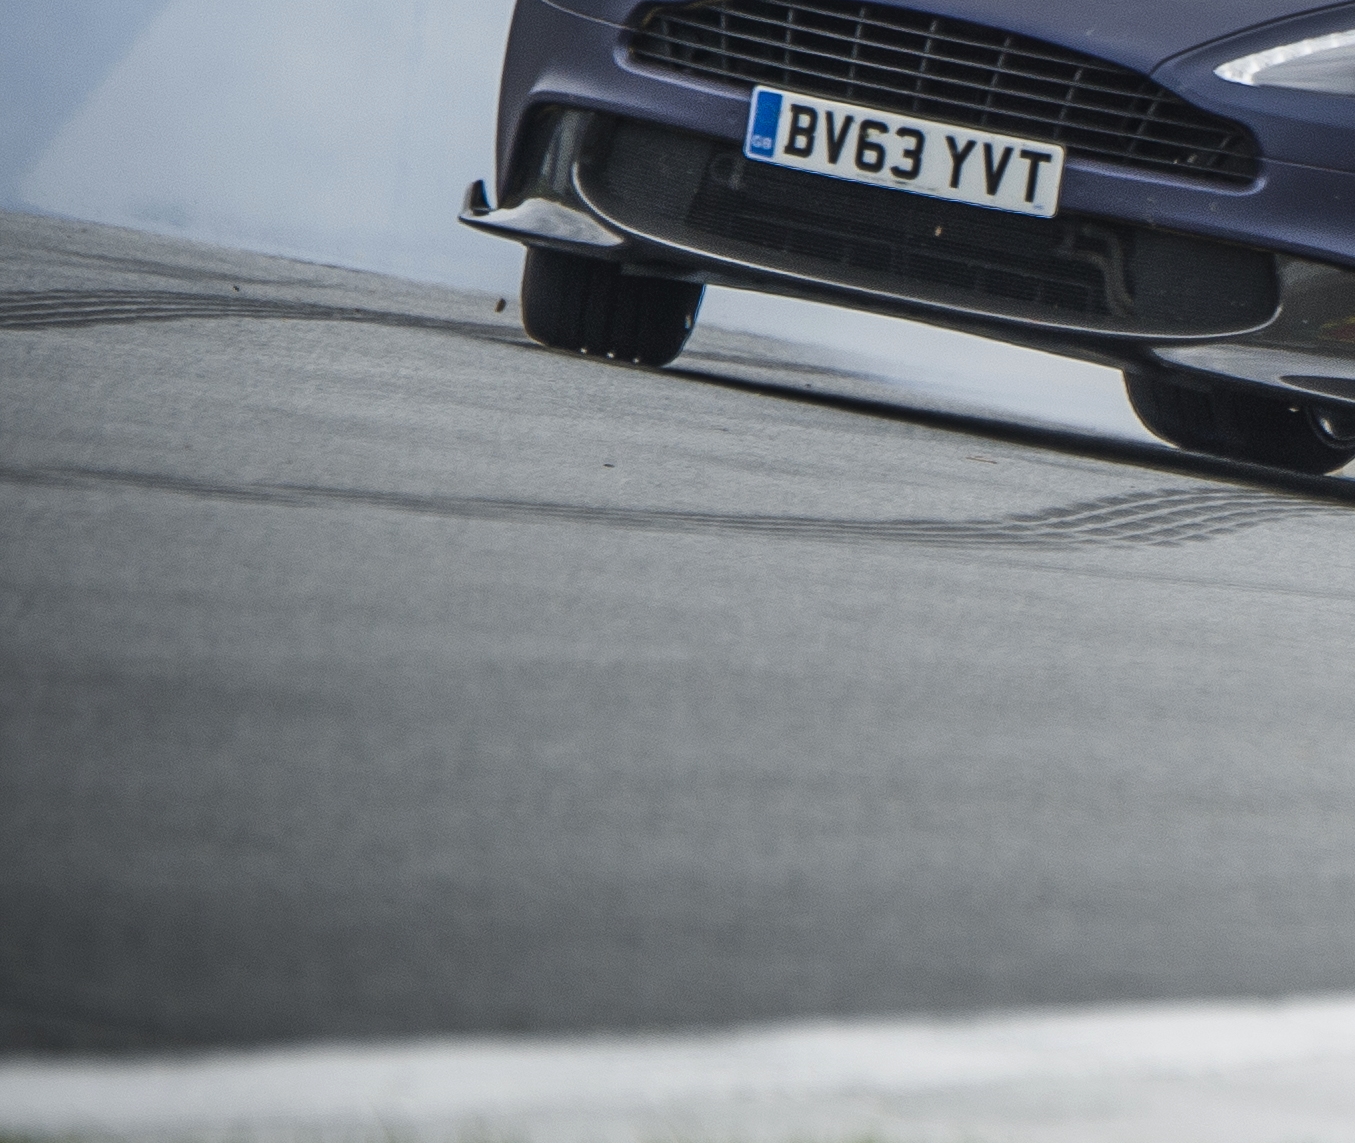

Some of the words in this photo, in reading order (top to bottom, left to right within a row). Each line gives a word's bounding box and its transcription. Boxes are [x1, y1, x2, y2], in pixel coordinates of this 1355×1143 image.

[751, 134, 772, 150] GB
[784, 103, 926, 181] BV63
[945, 135, 1054, 203] YVT
